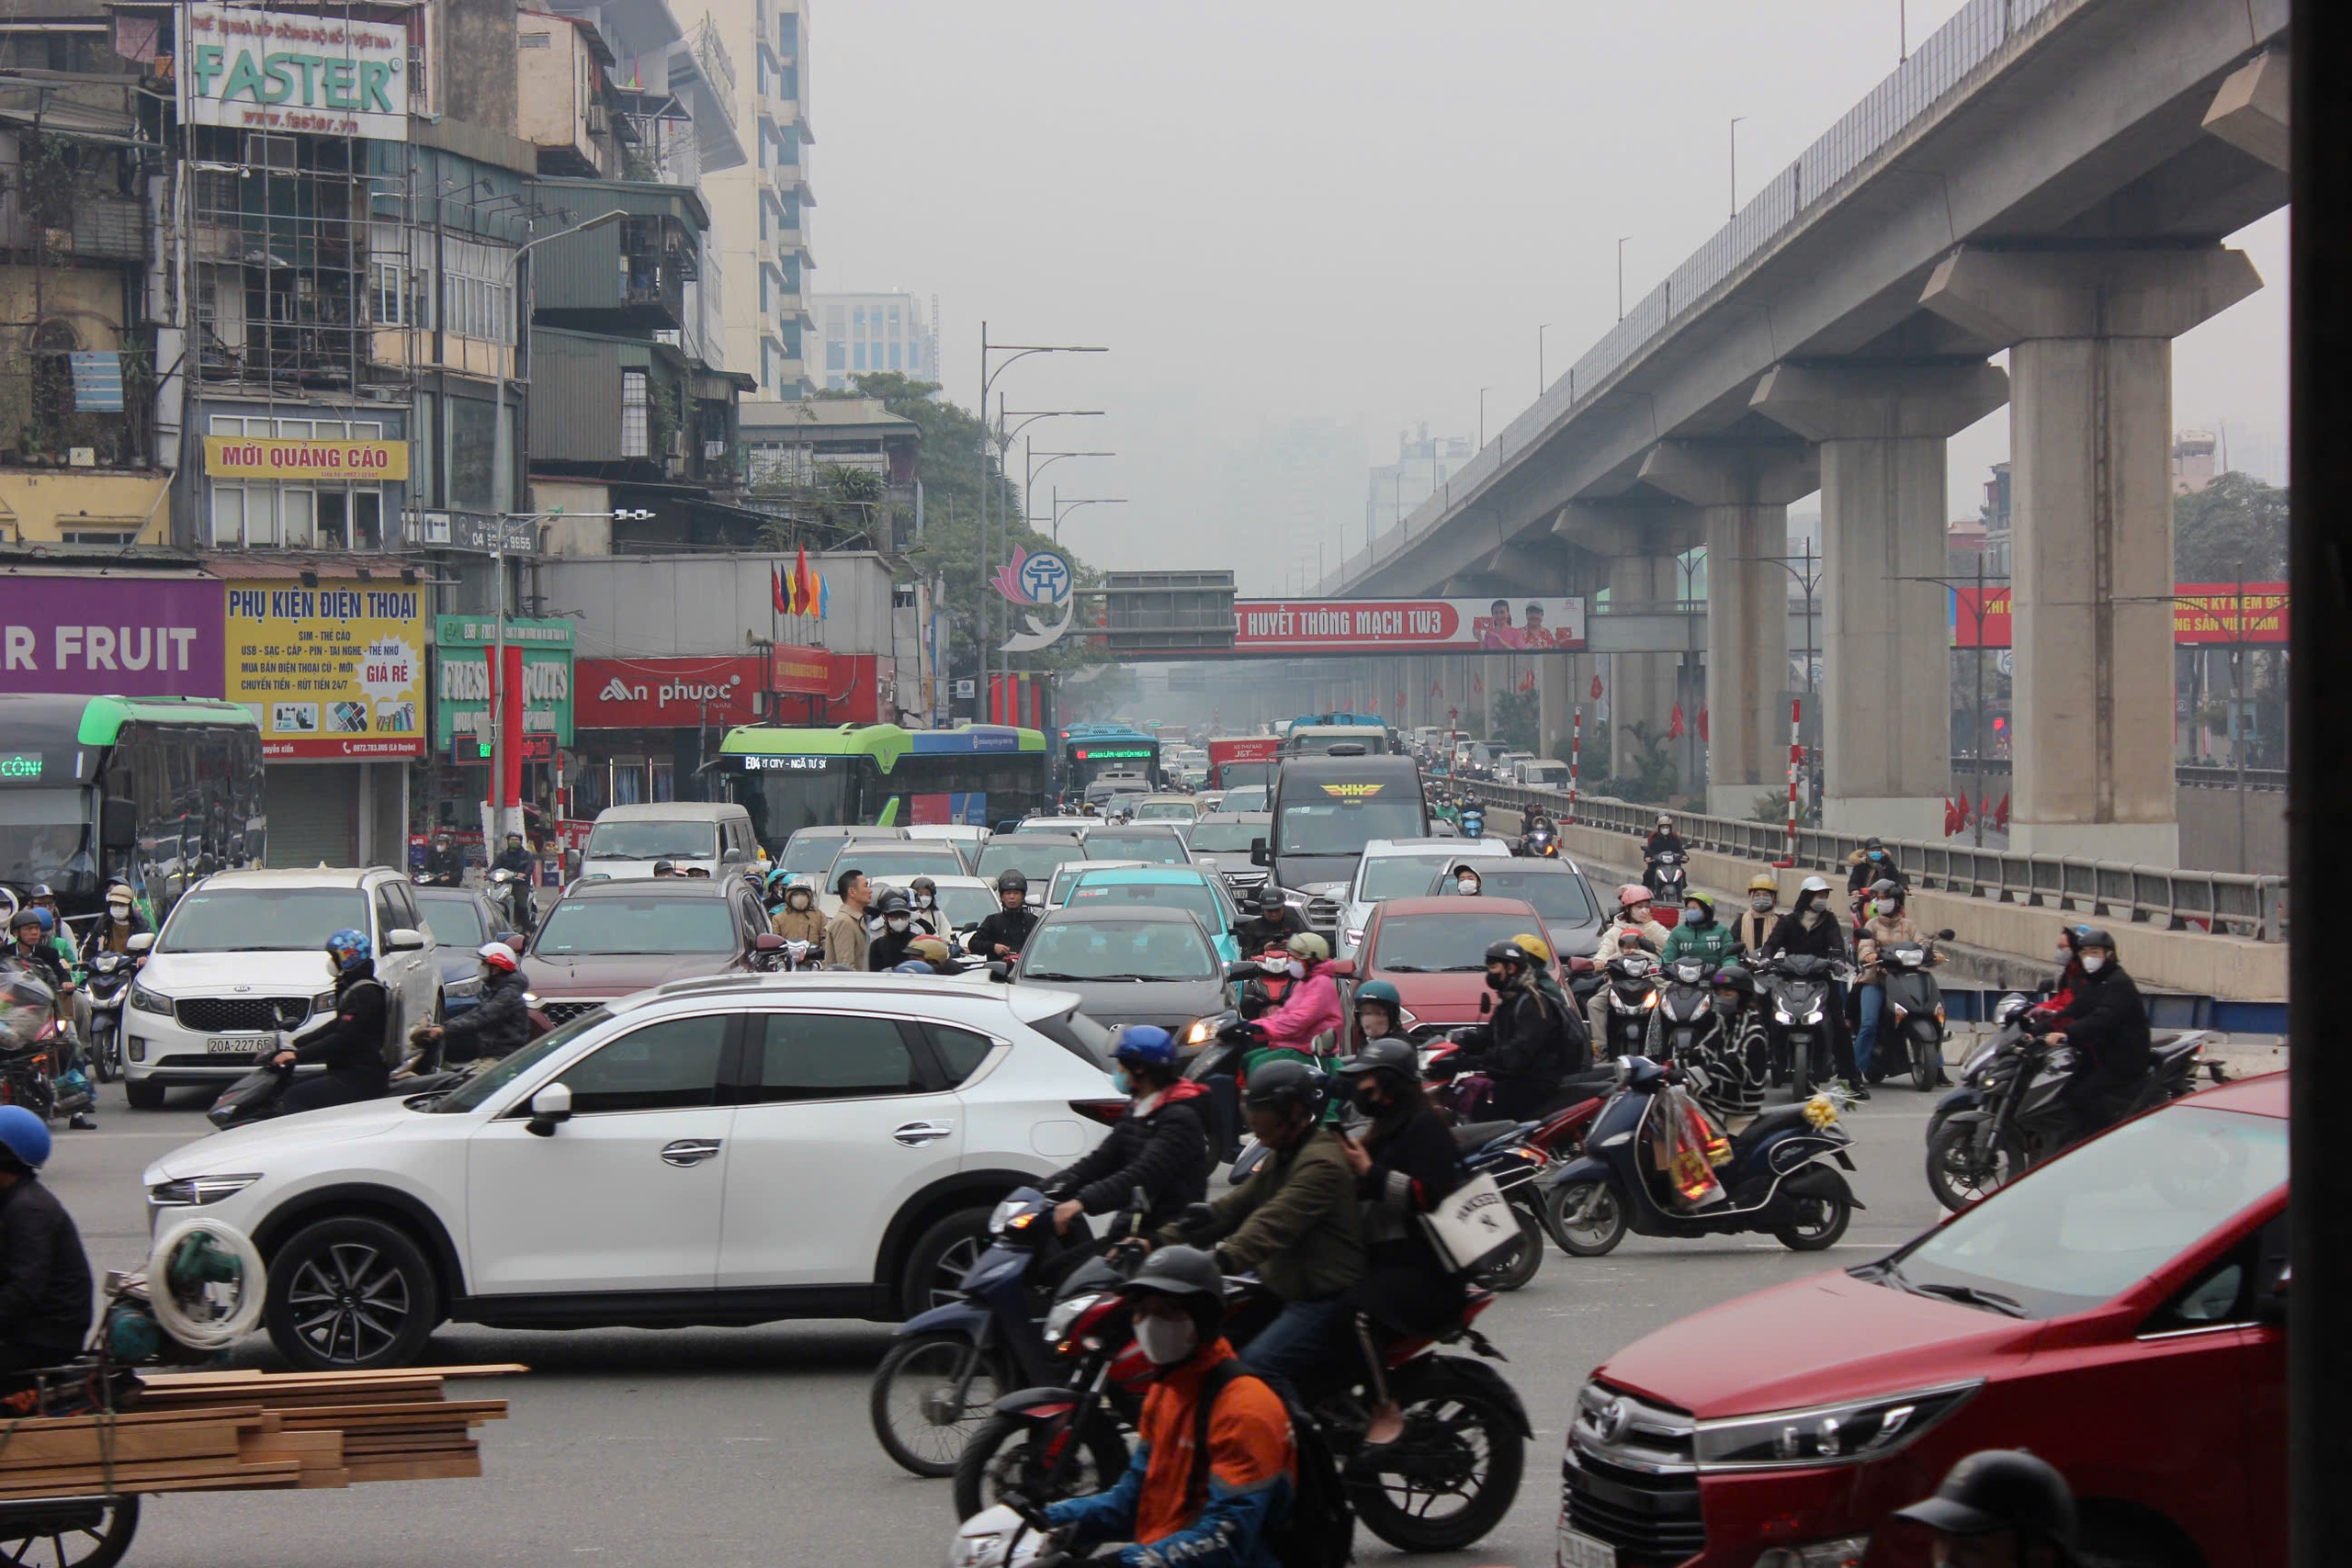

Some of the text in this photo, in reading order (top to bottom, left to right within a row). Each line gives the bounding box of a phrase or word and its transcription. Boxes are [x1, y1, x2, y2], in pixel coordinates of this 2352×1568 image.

[194, 44, 393, 112] FASTER
[243, 109, 359, 134] www.faster.vn
[222, 442, 388, 469] MỜI QUẢNG CÁO
[229, 584, 417, 624] PHỤ KIỆN ĐIỆN THOẠI
[2266, 596, 2281, 609] 95
[1248, 604, 1295, 637] HUYẾT
[1299, 608, 1350, 636] THÔNG
[1356, 611, 1403, 639] MẠCH
[1408, 612, 1442, 634] TW3
[2250, 616, 2278, 630] NAM
[299, 631, 313, 641] SIM
[0, 626, 197, 671] R FRUIT
[241, 646, 257, 656] USB
[309, 646, 322, 656] PIN
[330, 646, 340, 656] TAI
[342, 646, 362, 656] NGHE
[241, 662, 258, 672] MUA
[368, 660, 408, 682] GIÁ RẺ
[332, 679, 348, 690] 24/7
[745, 757, 761, 770] E04
[770, 759, 785, 769] CITY
[791, 757, 806, 769] NGÃ
